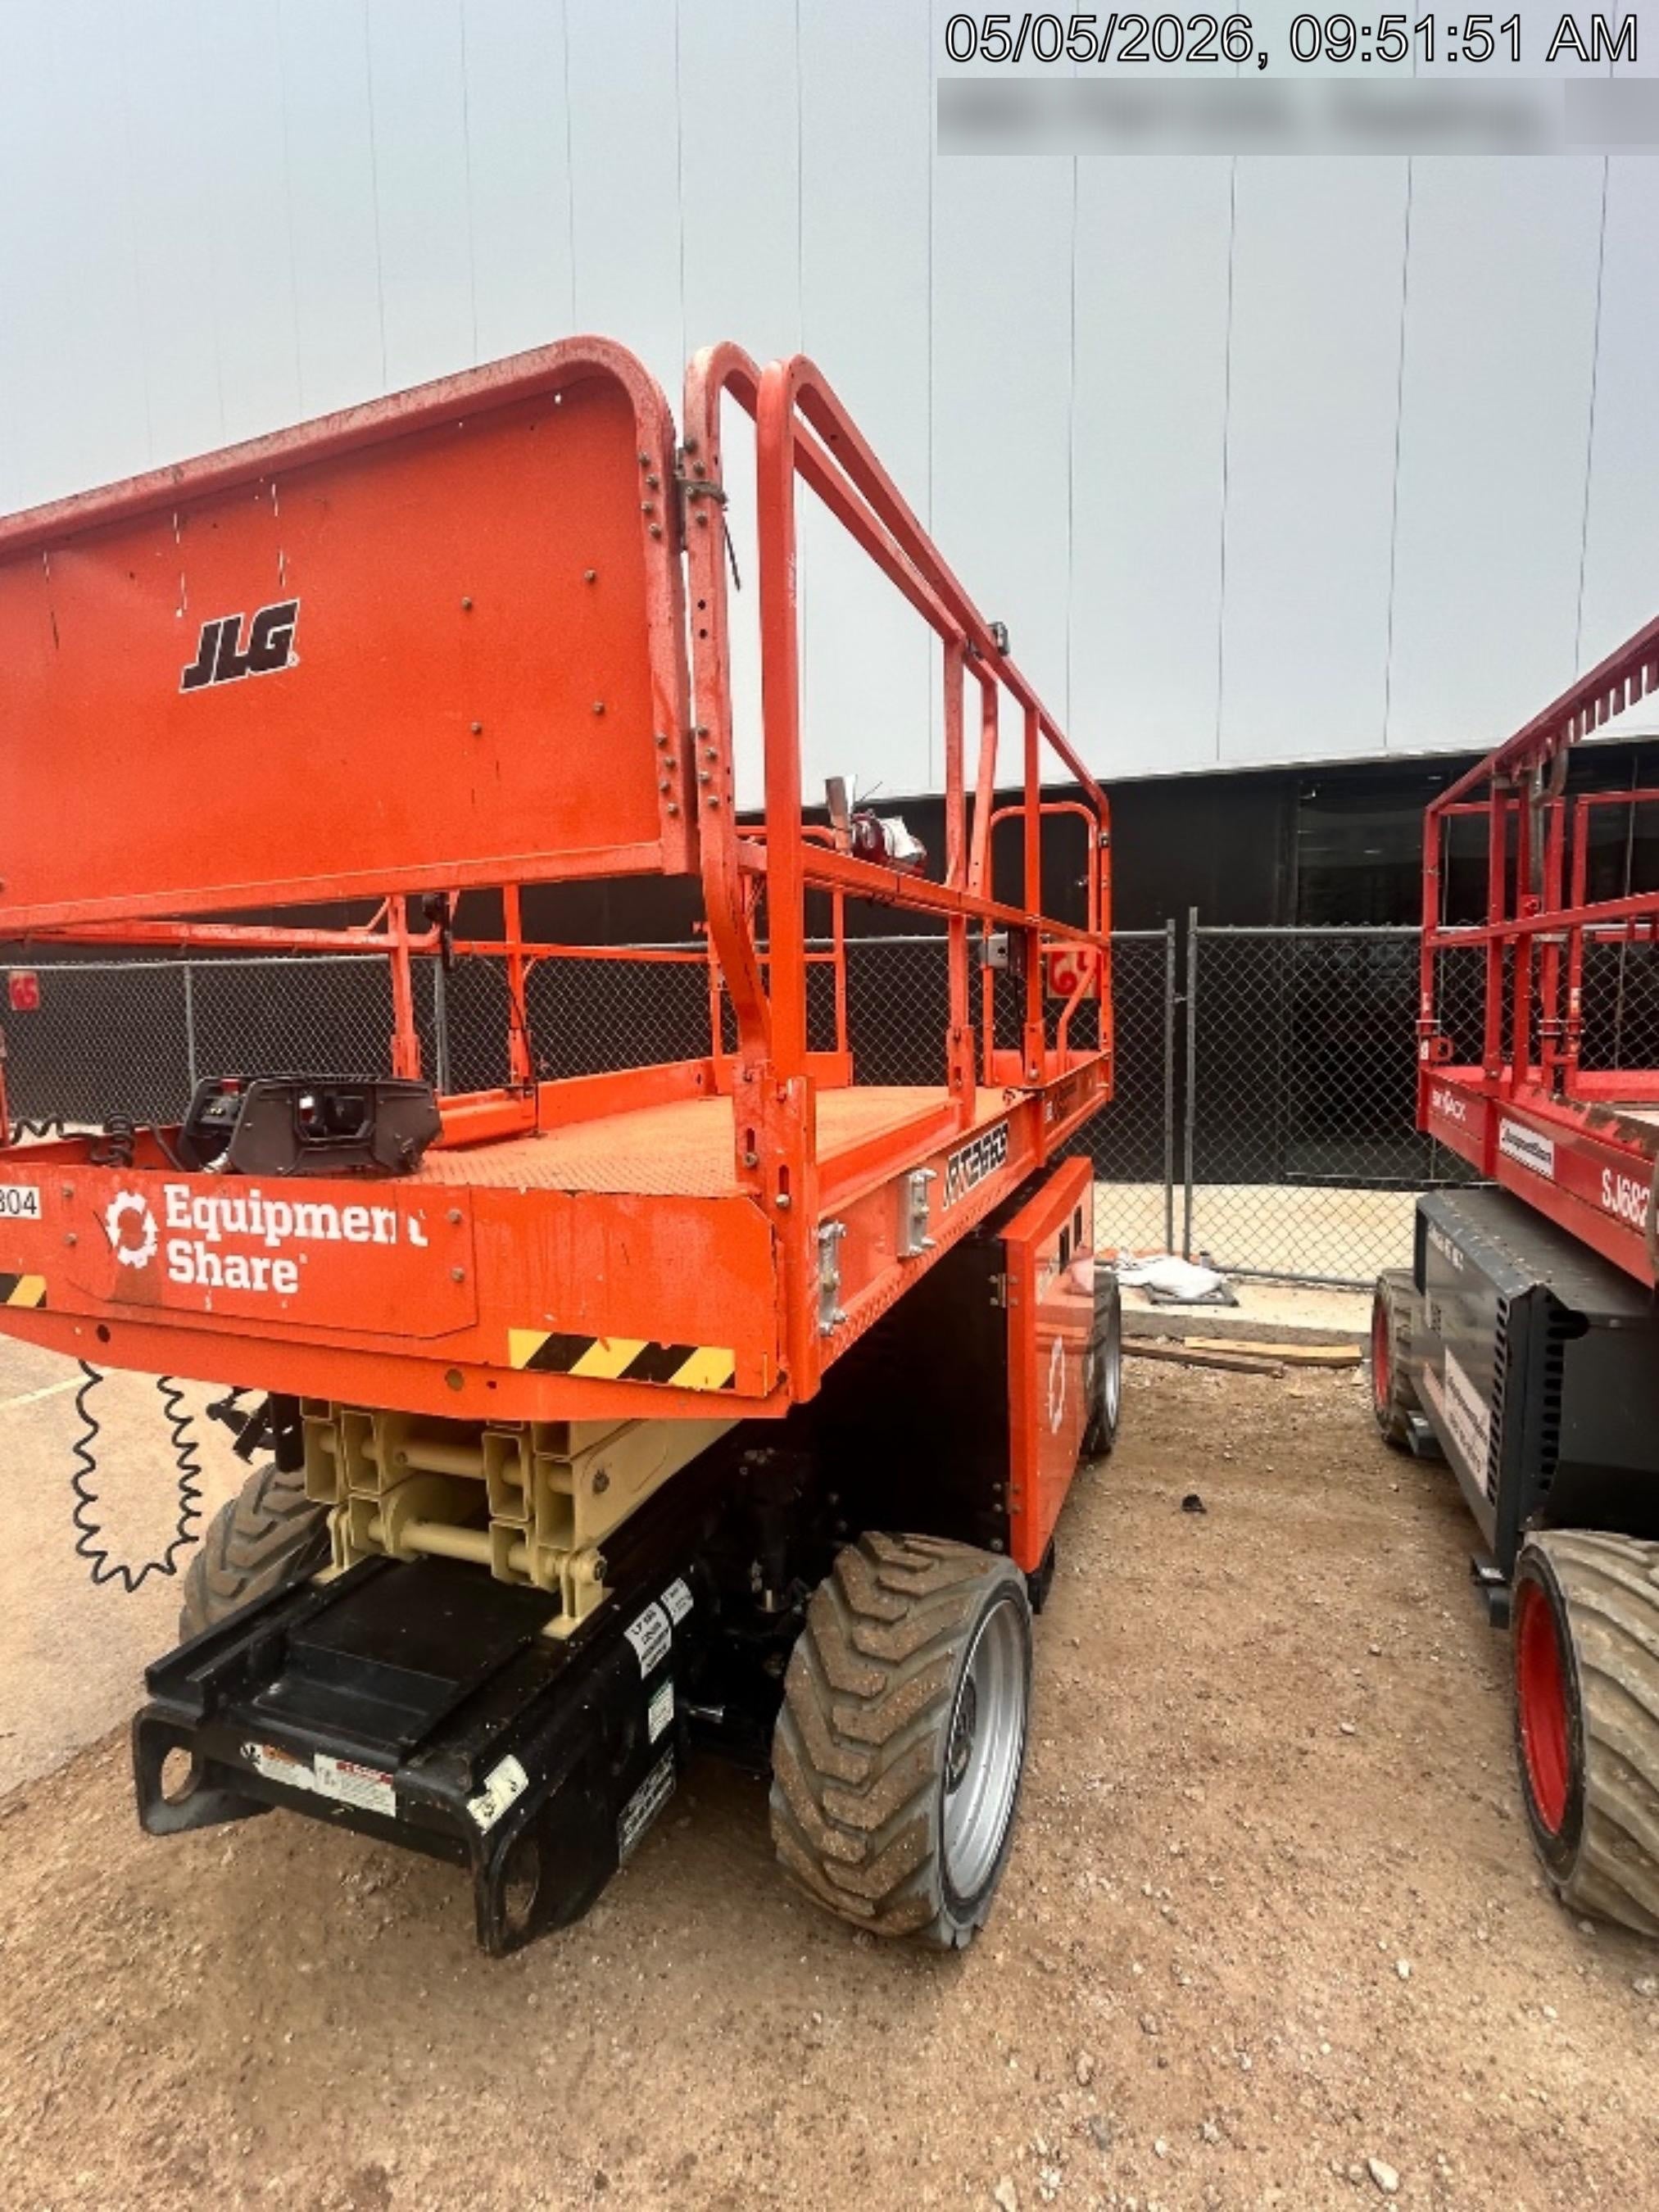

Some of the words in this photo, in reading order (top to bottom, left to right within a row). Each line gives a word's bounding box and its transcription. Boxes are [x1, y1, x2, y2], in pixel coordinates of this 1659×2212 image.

[179, 596, 301, 694] JLG
[1601, 1166, 1659, 1235] SJ682
[166, 1238, 299, 1294] Share
